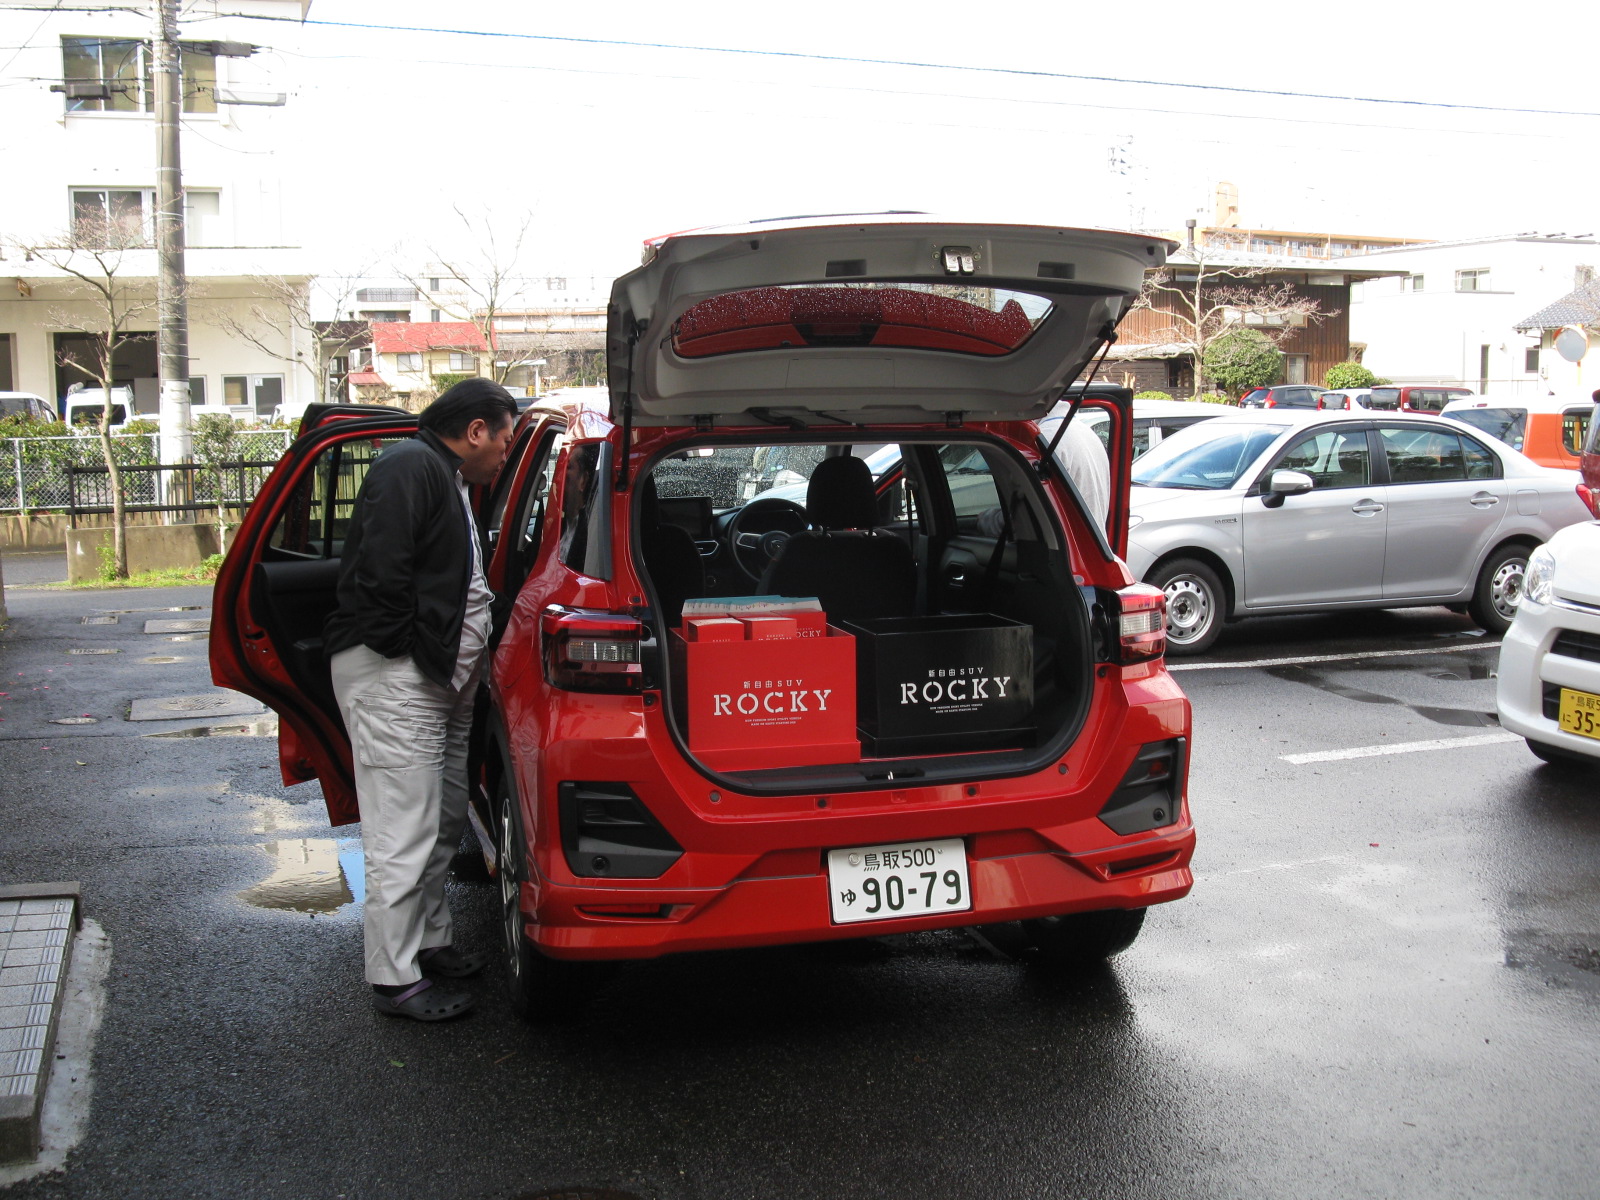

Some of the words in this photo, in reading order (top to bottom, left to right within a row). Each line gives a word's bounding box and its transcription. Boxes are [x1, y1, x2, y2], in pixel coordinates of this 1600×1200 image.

[796, 629, 822, 639] OCKY
[713, 689, 832, 716] ROCKY
[900, 676, 1011, 705] ROCKY
[1563, 713, 1571, 723] に
[840, 888, 857, 907] ゆ
[862, 869, 962, 914] 90-79
